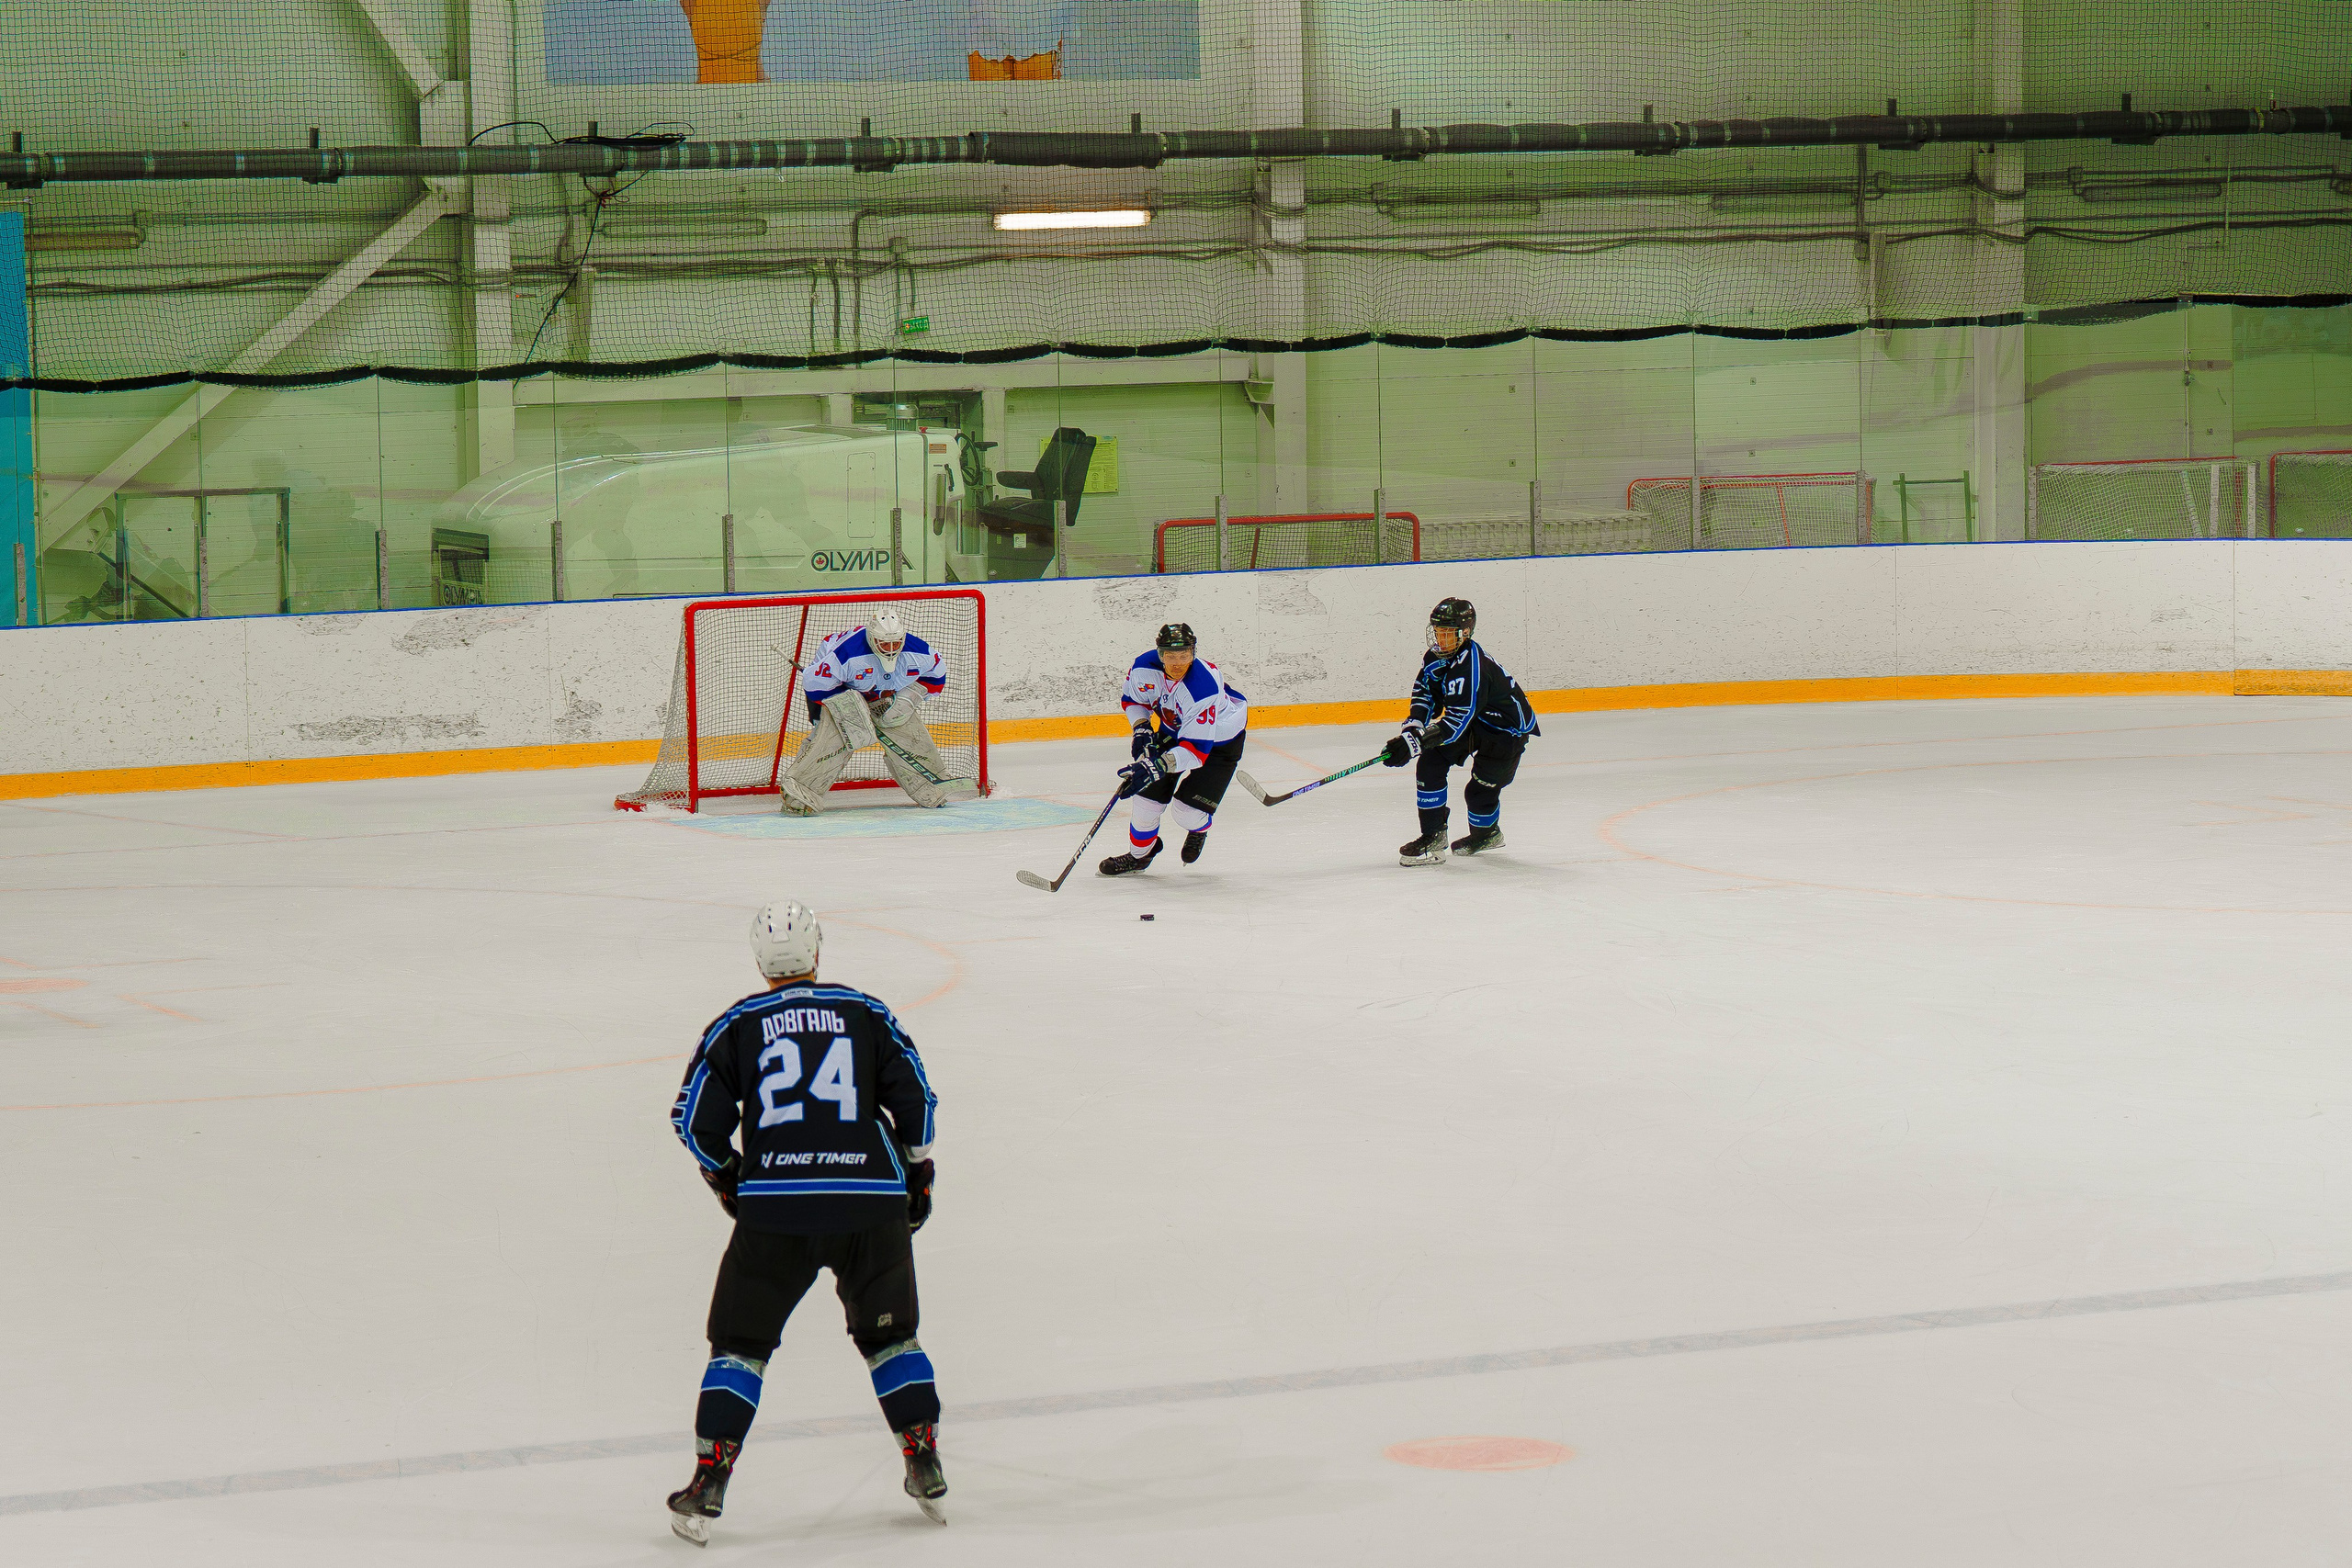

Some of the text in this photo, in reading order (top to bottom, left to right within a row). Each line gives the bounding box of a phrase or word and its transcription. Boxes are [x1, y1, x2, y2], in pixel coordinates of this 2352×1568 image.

[878, 735, 939, 783] BAUER
[762, 1009, 845, 1045] ДОВГАЛЬ
[758, 1036, 858, 1130] 24
[775, 1152, 867, 1166] ONE TIMER
